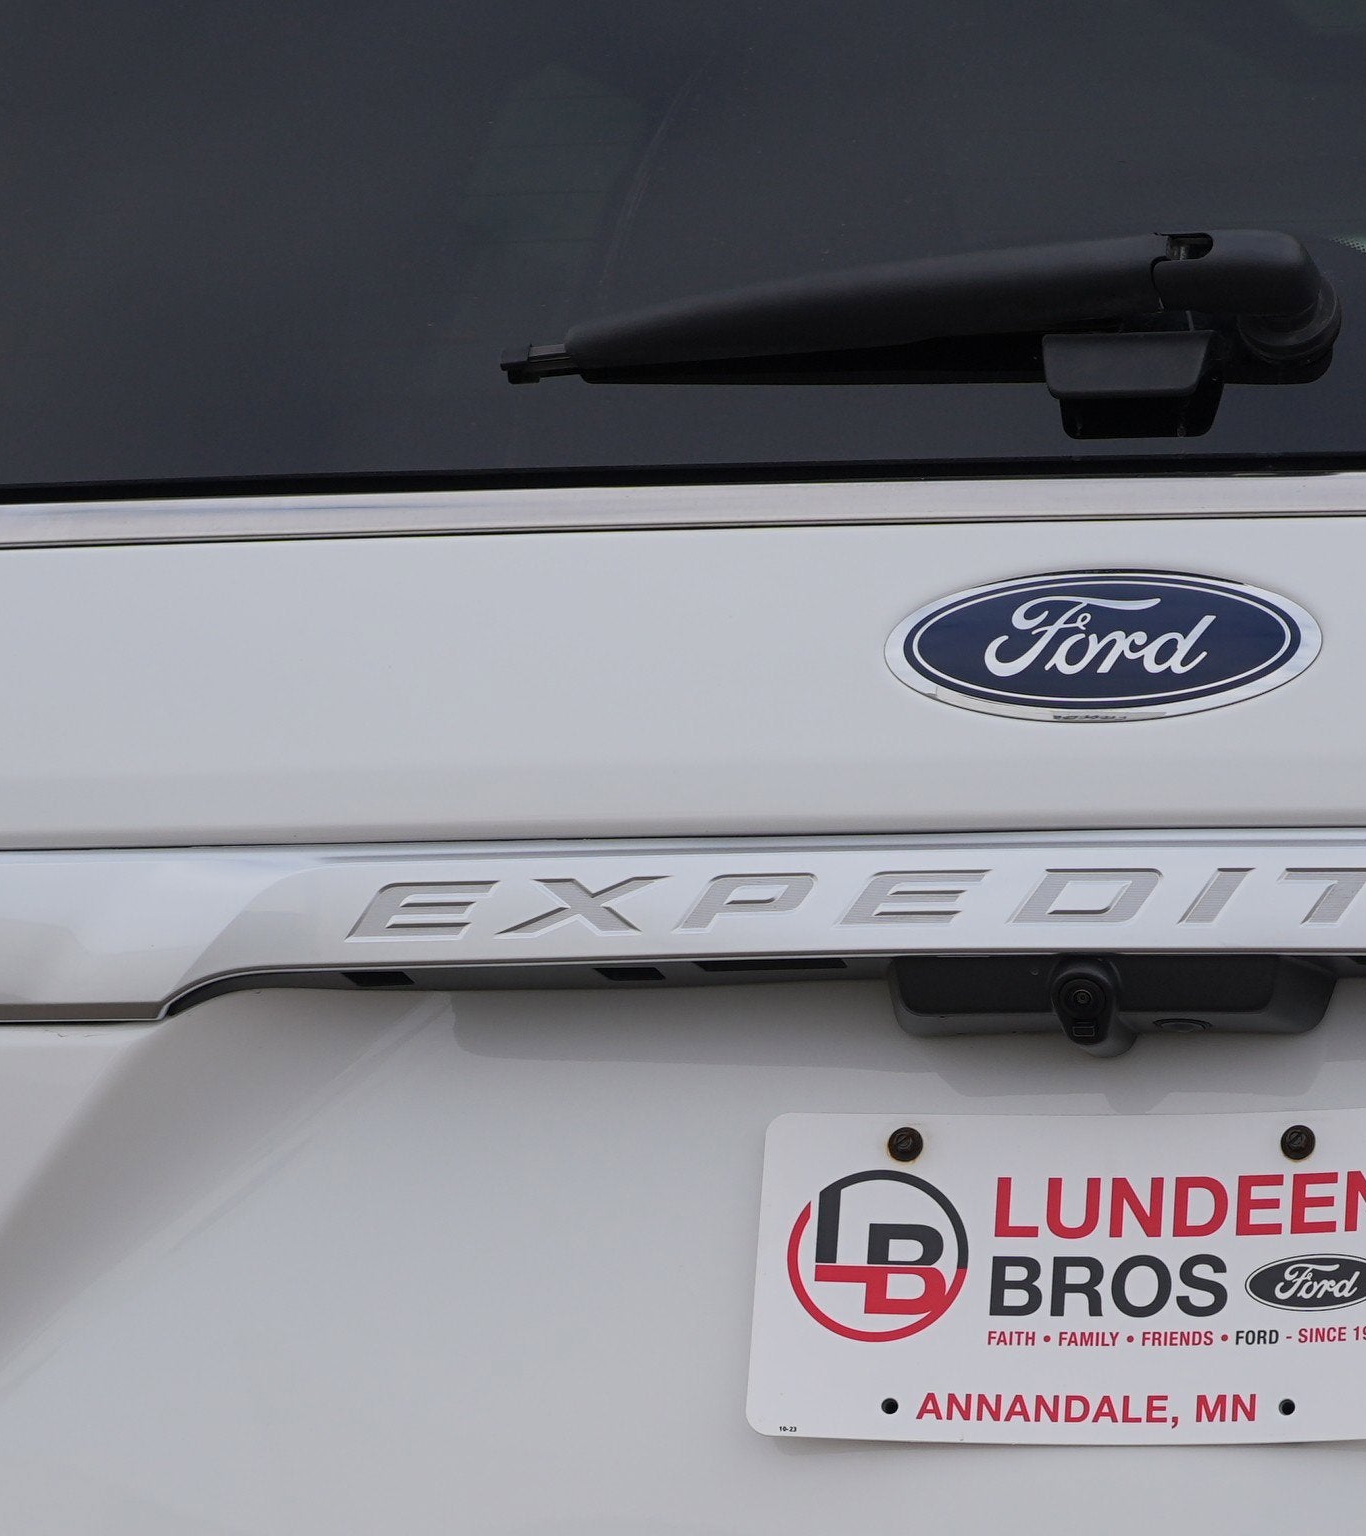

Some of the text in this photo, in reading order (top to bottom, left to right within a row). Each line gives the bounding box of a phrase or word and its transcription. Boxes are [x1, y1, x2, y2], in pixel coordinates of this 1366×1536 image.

[984, 596, 1217, 677] Ford
[988, 1254, 1228, 1318] BROS
[1274, 1263, 1361, 1300] Ford
[987, 1331, 1036, 1347] FAITH
[1058, 1331, 1120, 1347] FAMILY
[1141, 1331, 1214, 1347] FRIENDS
[1235, 1330, 1280, 1346] FORD
[1297, 1327, 1347, 1344] SINCE
[915, 1393, 1257, 1429] ANNANDALE, MN
